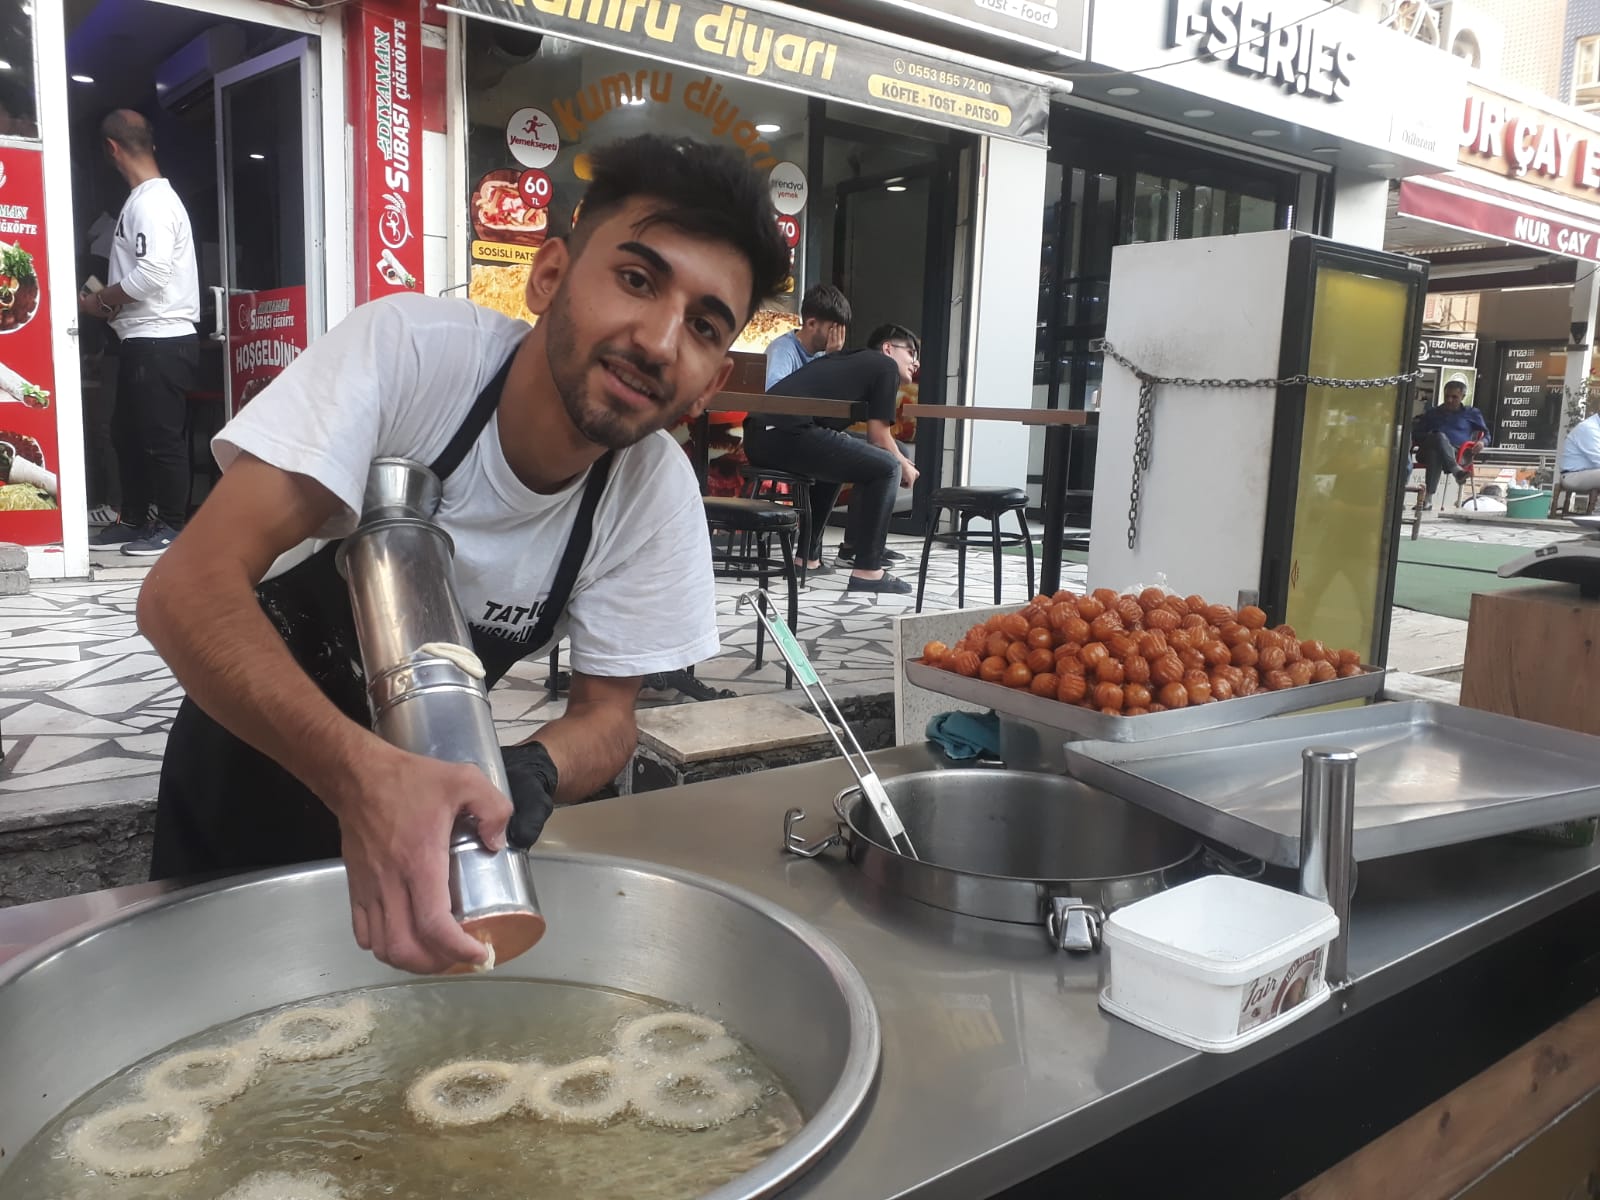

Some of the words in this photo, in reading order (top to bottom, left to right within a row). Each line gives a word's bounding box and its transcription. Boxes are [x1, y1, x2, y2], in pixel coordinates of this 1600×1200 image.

[513, 0, 682, 43] mru
[694, 4, 838, 80] diyarı
[908, 63, 938, 81] 0553
[939, 71, 960, 88] 855
[962, 77, 976, 91] 72
[977, 81, 992, 95] 00
[882, 81, 920, 105] KÖFTE
[928, 94, 956, 113] TOST
[965, 103, 999, 122] PATSO
[385, 102, 410, 192] SUBAŞI
[1511, 112, 1578, 178] ÇAY
[524, 176, 548, 196] 60
[531, 197, 540, 205] TL
[777, 191, 799, 199] yemek
[1514, 215, 1550, 246] NUR
[1557, 228, 1593, 254] ÇAY
[478, 246, 513, 259] SOSİSLİ
[1429, 339, 1447, 349] TERZİ
[1447, 341, 1475, 351] MEHMET
